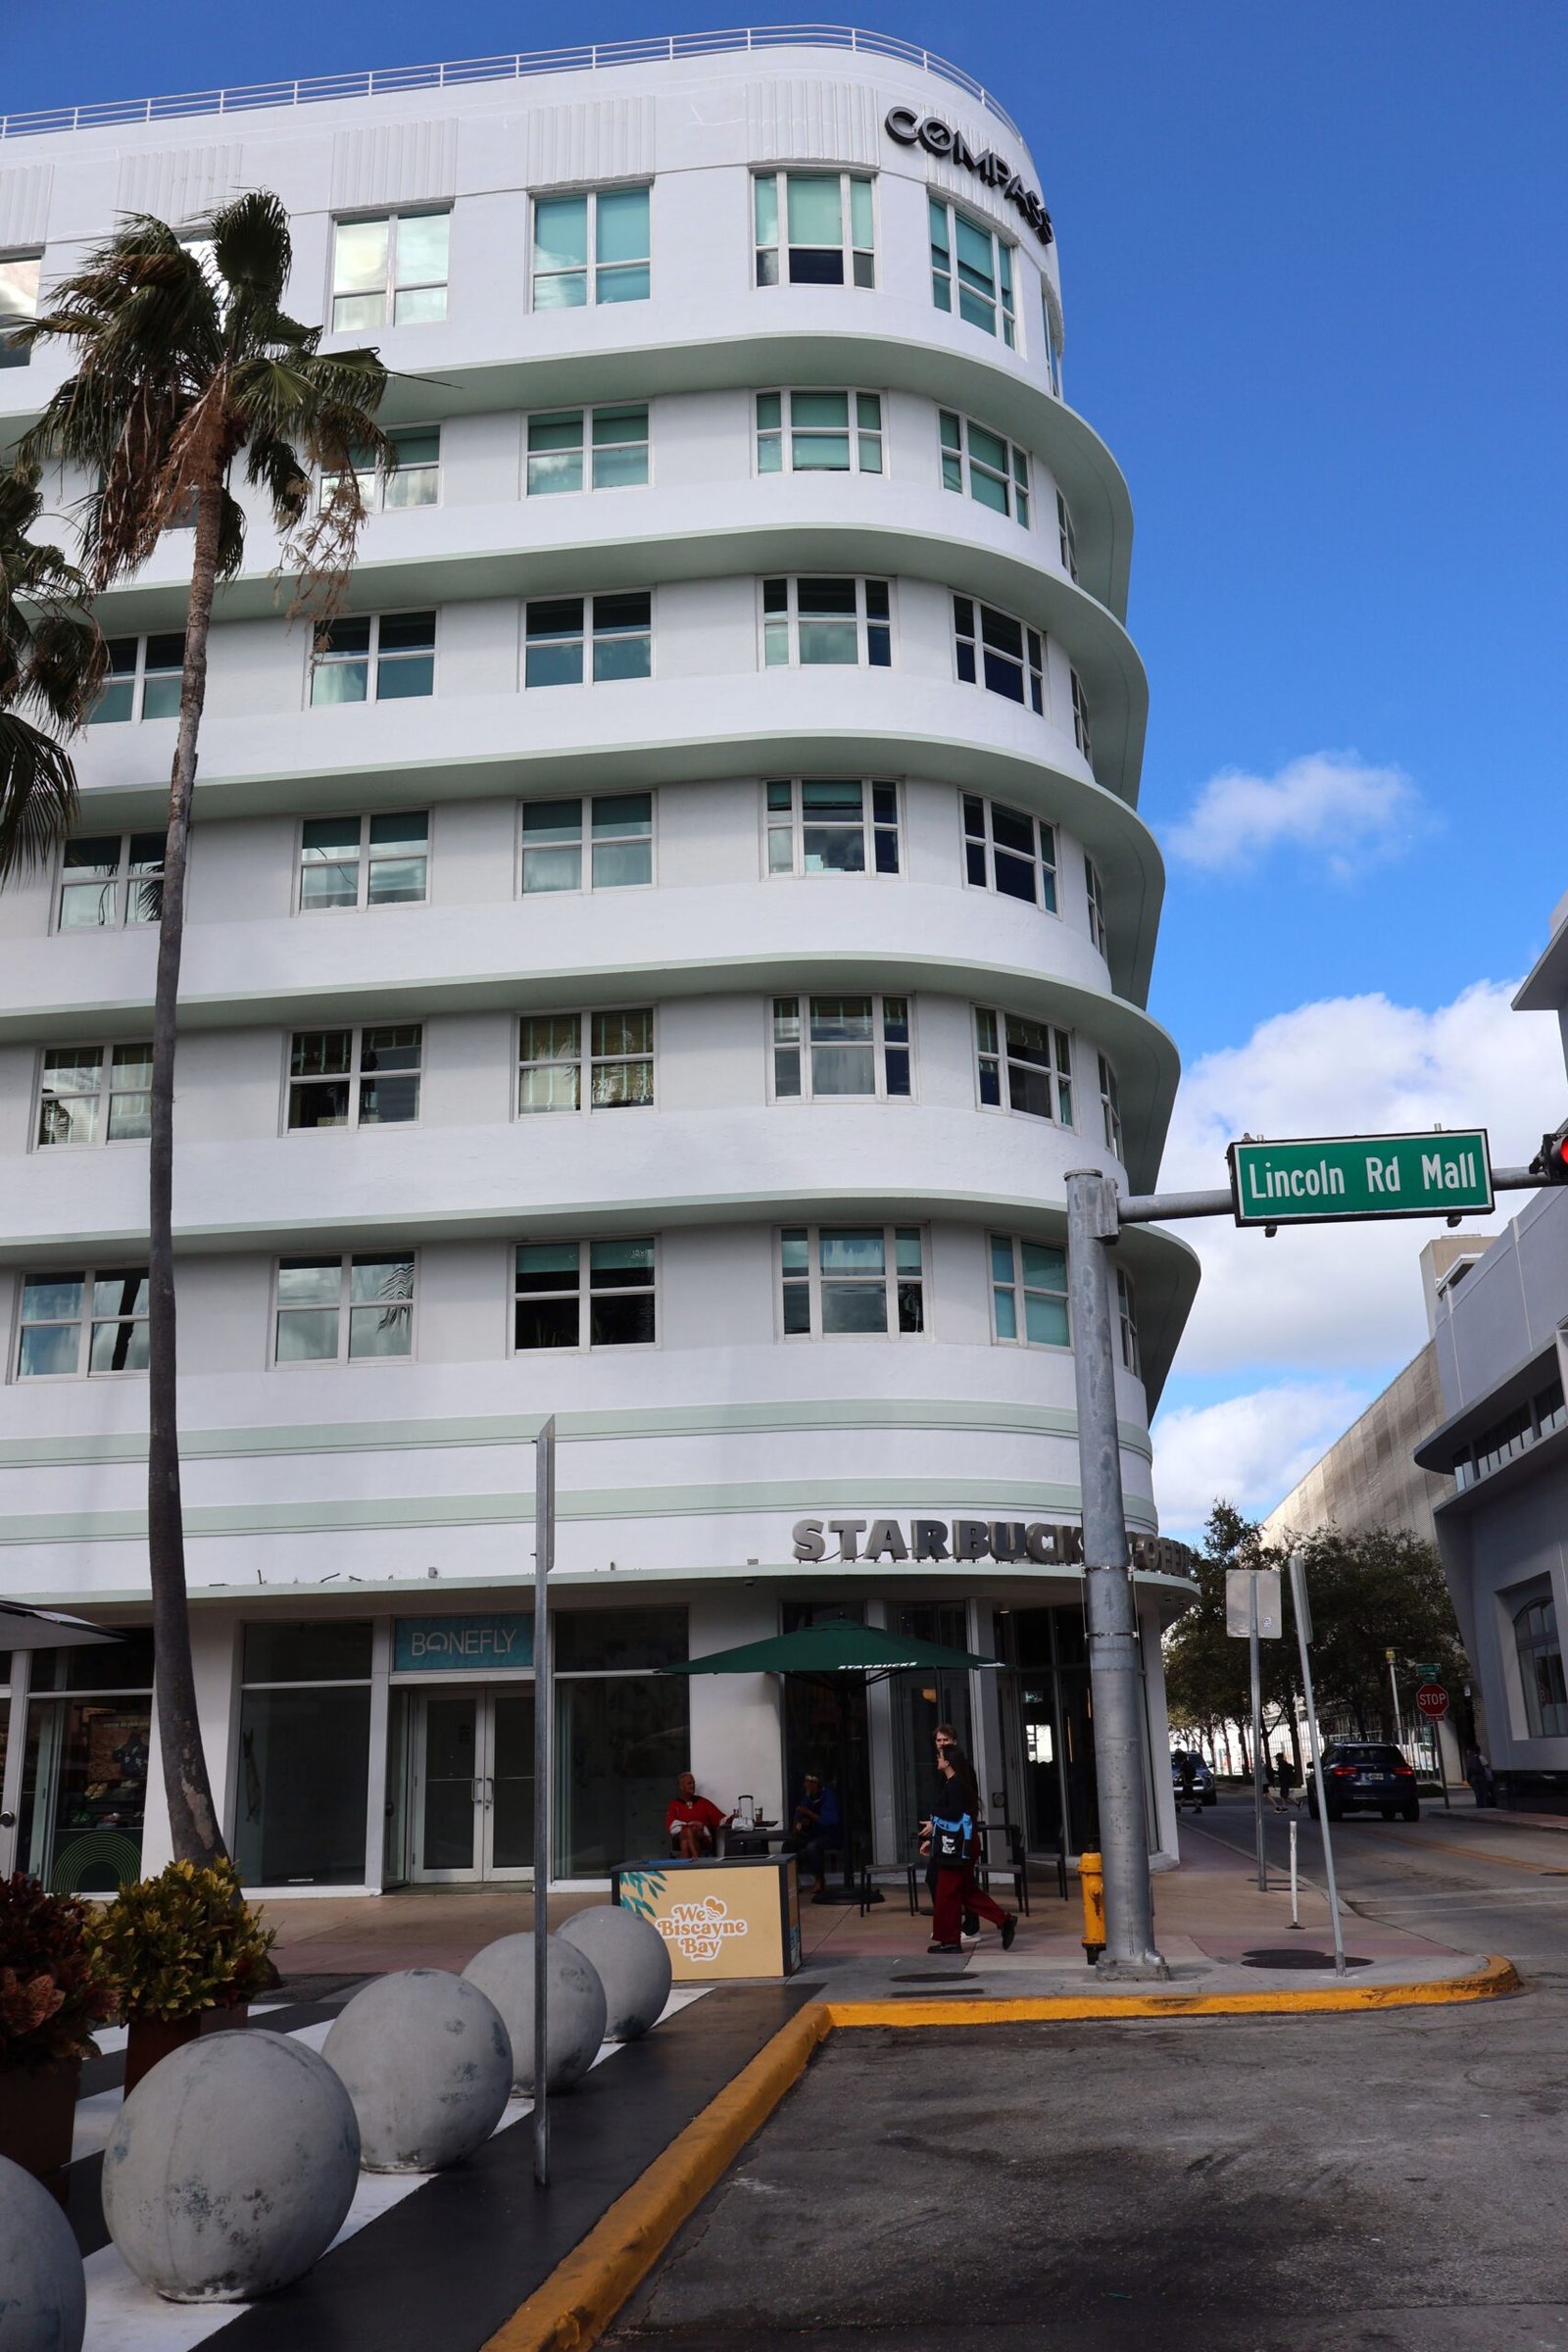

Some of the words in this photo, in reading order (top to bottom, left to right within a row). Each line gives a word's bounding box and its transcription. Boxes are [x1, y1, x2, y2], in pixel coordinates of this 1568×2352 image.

[885, 106, 1054, 244] COMPASS
[1250, 1159, 1346, 1199] Lincoln
[1365, 1155, 1400, 1193] Rd
[1421, 1152, 1477, 1190] Mall
[792, 1519, 1083, 1561] STARBUCK
[411, 1629, 517, 1656] BONEFLY
[1419, 1692, 1446, 1705] STOP
[674, 1906, 706, 1922] We
[658, 1919, 745, 1939] Biscayne
[681, 1938, 719, 1958] Bay
